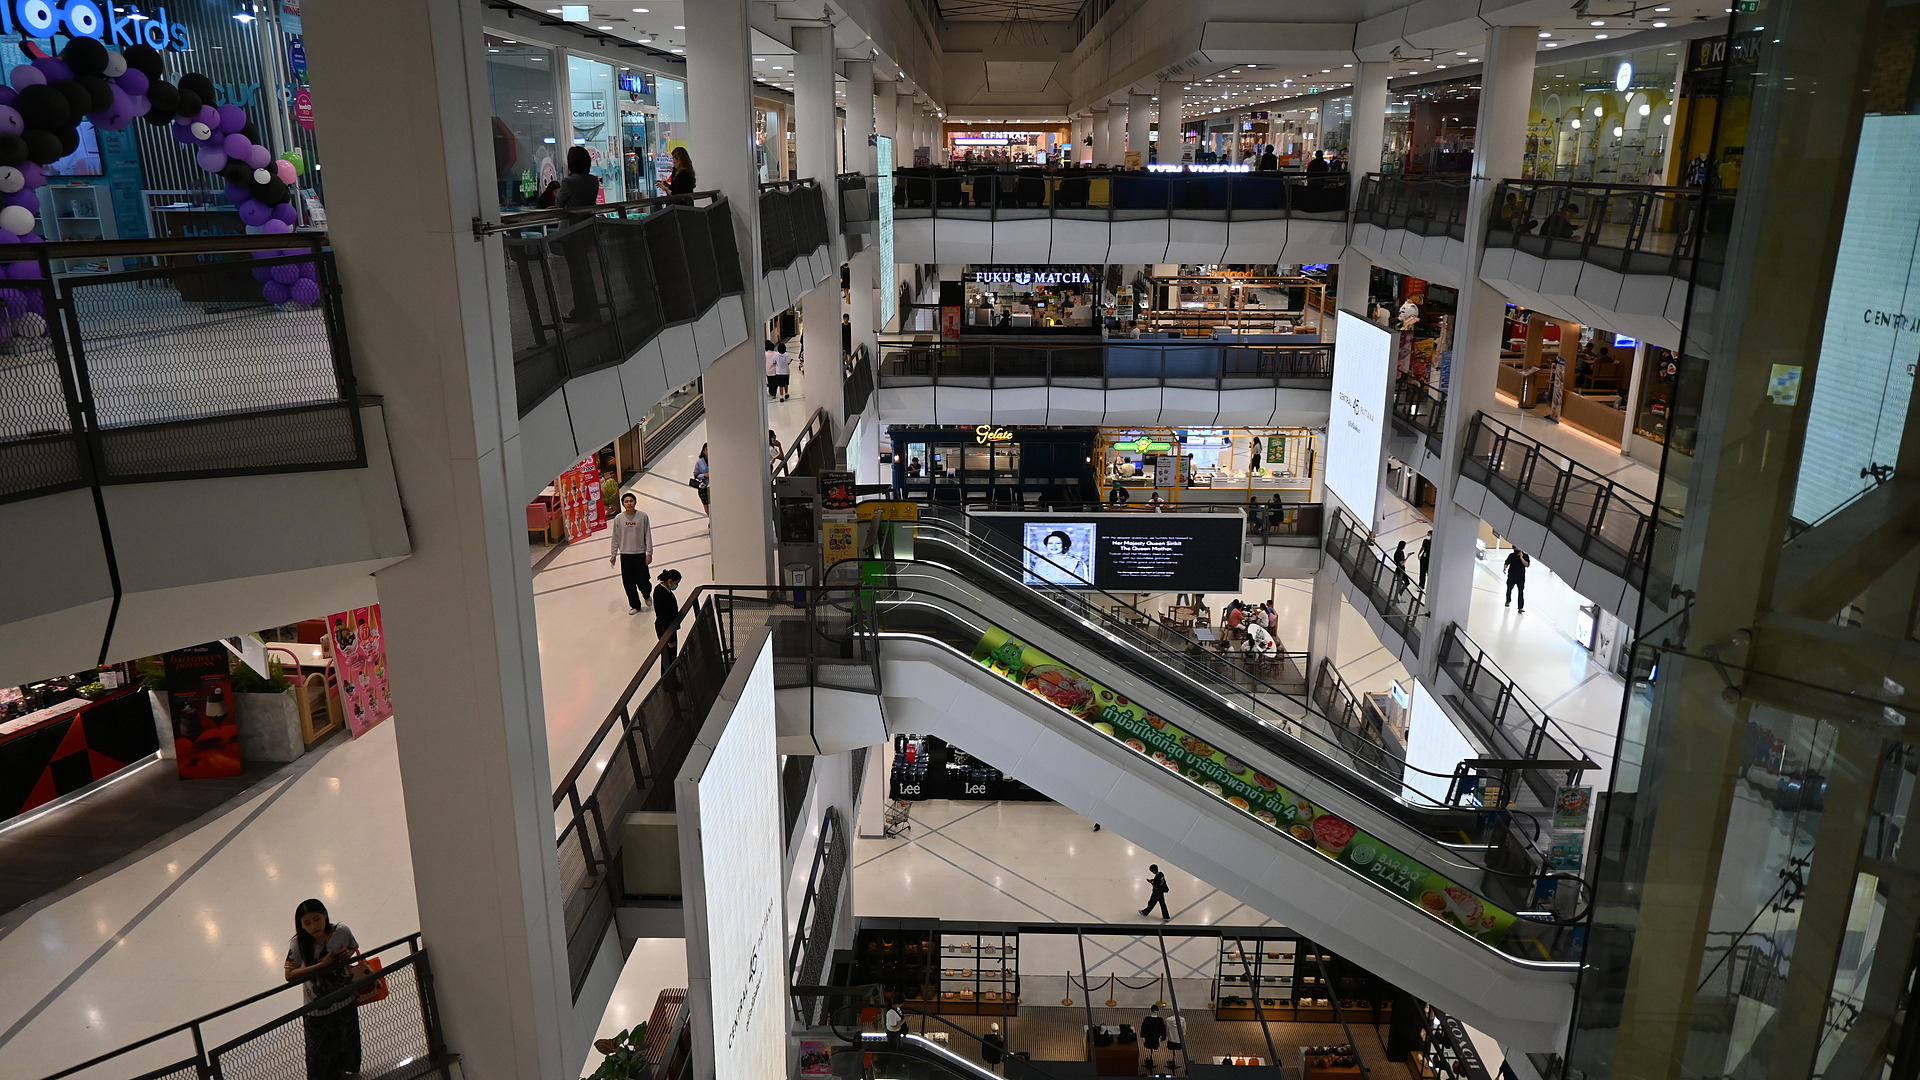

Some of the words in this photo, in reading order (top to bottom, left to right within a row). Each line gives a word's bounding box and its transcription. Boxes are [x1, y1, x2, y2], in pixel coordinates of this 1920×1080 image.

[975, 272, 1011, 283] FUKU
[1034, 272, 1091, 283] MATCHA
[1100, 705, 1183, 762] ทำมื้อนี้ให้ดีที่สุด
[1184, 753, 1263, 804] บาร์บีคิวพลาซ่า
[1264, 797, 1281, 815] ชั้น
[1283, 806, 1296, 821] 4
[899, 782, 921, 795] Lee
[965, 782, 986, 795] Lee
[1370, 864, 1411, 892] PLAZA
[1446, 1018, 1481, 1070] COACH
